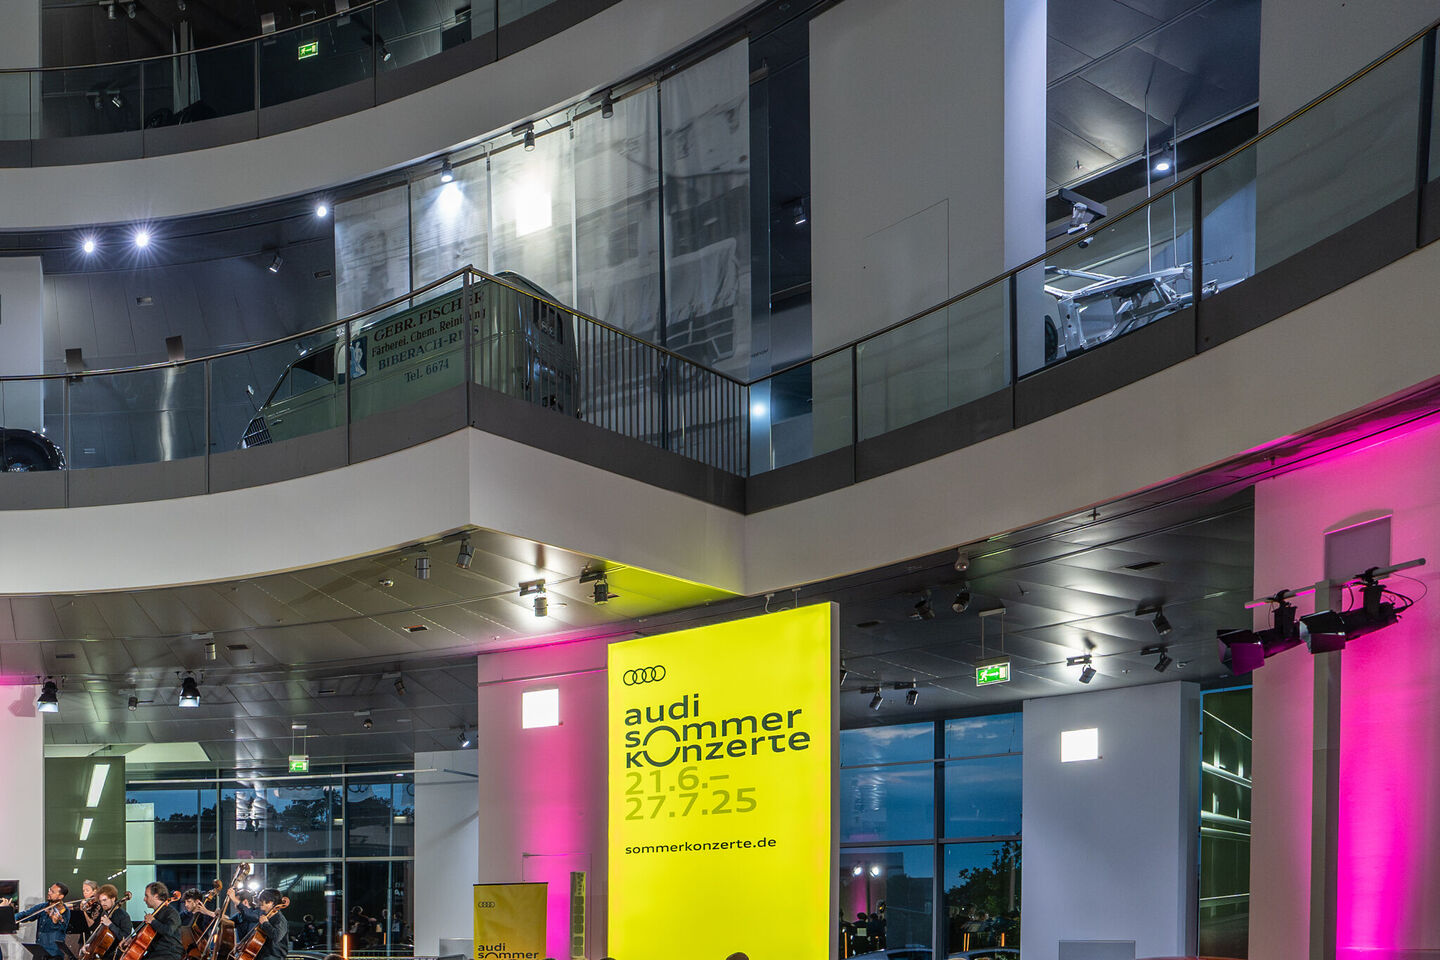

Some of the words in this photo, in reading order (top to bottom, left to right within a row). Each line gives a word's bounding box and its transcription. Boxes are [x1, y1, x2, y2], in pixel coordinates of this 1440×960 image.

[374, 317, 416, 342] GEBR.
[378, 325, 479, 370] BIBERACH-RIS
[404, 368, 423, 383] Tel.
[425, 358, 450, 375] 6674
[624, 693, 699, 726] audi
[625, 787, 758, 821] 27.7.25
[625, 837, 777, 855] sommerkonzerte.de
[478, 943, 506, 951] audi
